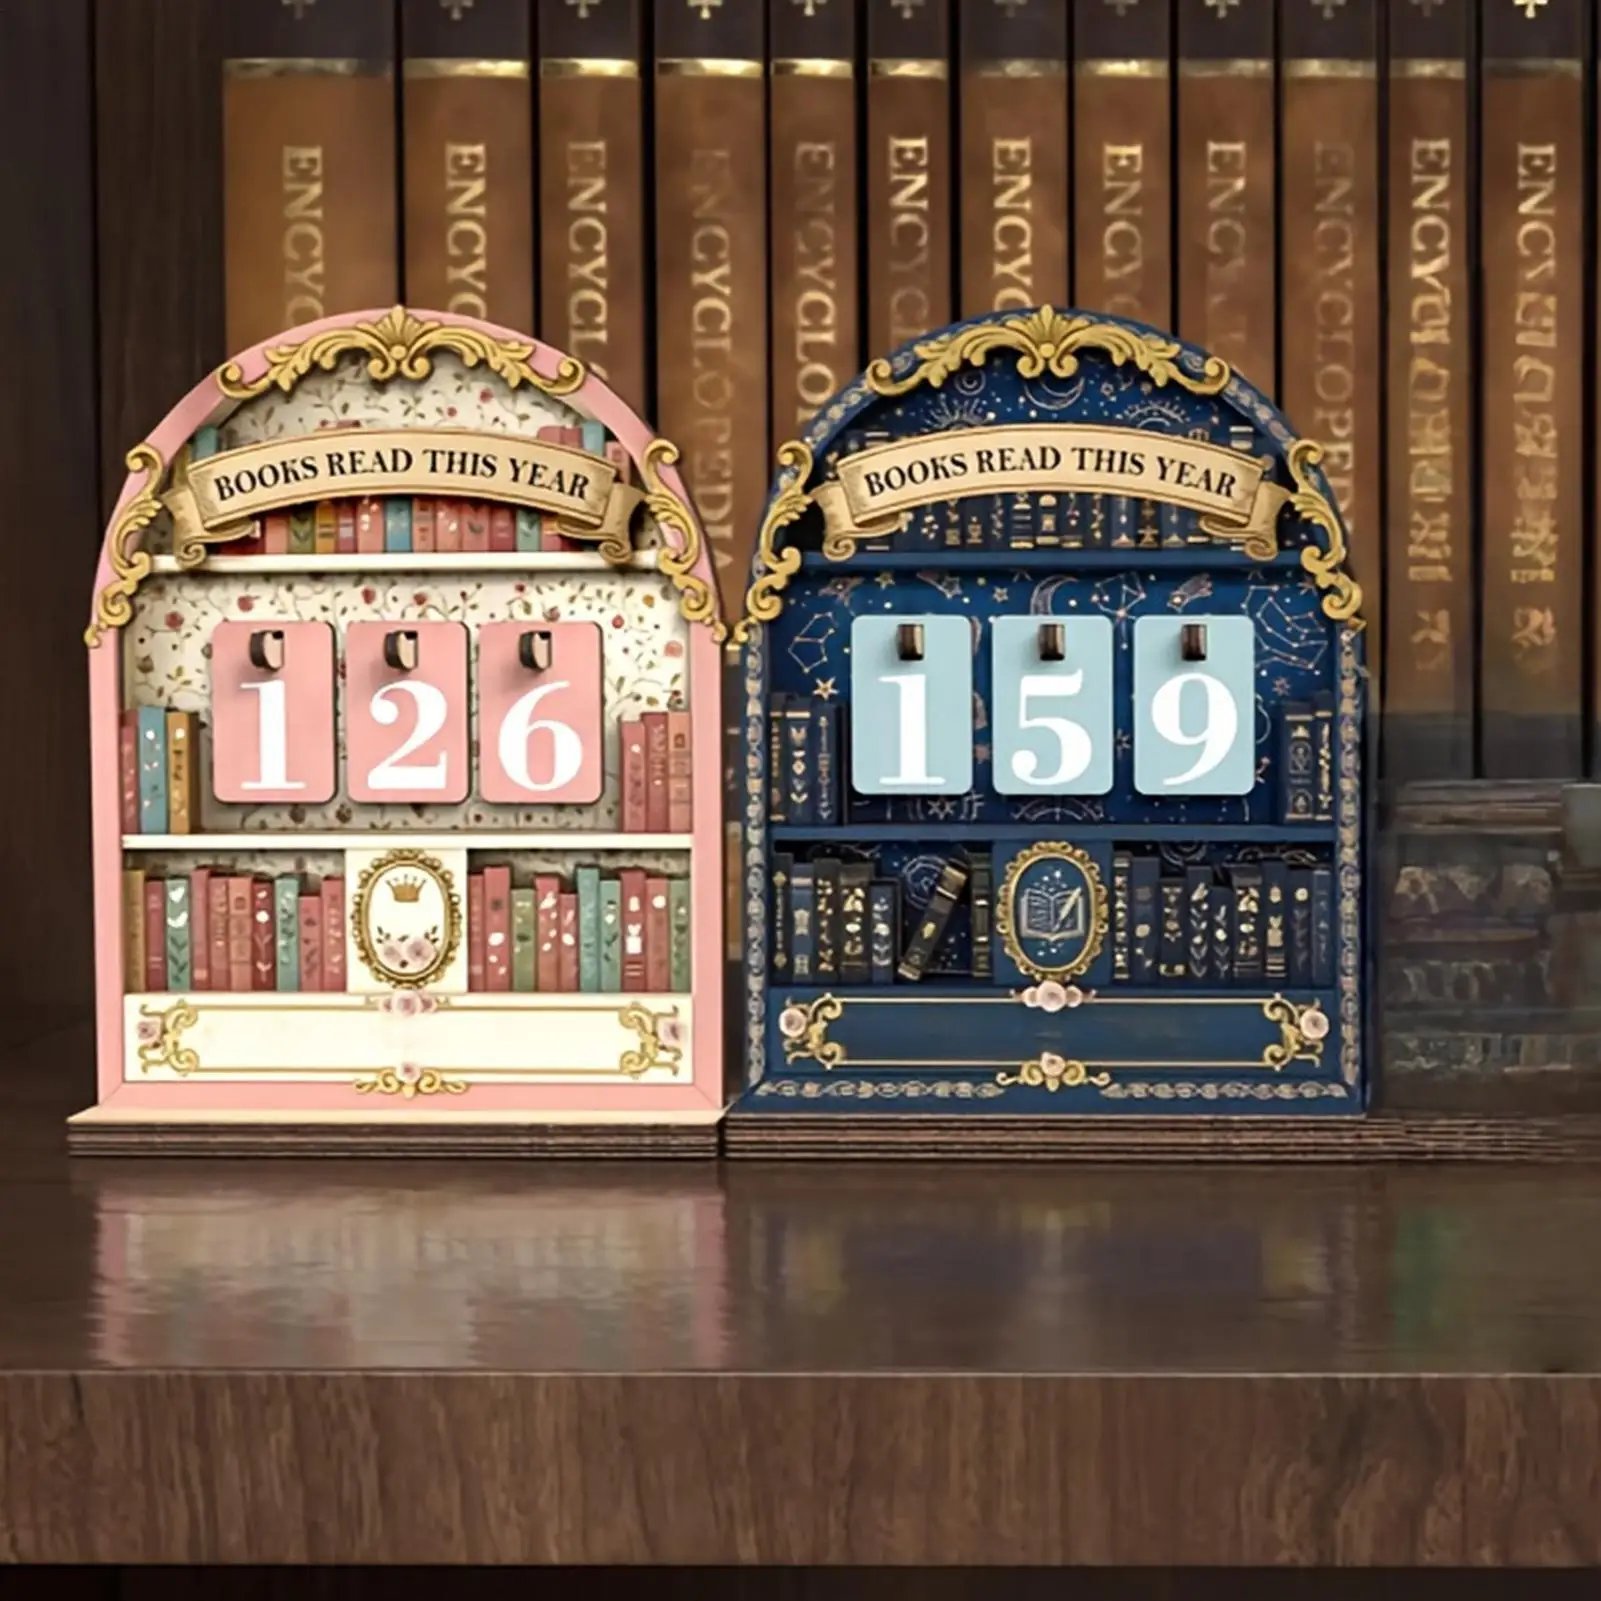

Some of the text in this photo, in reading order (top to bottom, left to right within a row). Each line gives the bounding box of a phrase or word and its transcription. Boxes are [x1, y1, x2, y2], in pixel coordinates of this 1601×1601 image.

[567, 139, 607, 380] ENCYCL
[214, 448, 590, 502] BOOKS READ THIS YEAR
[864, 446, 1237, 499] BOOKS READ THIS YEAR
